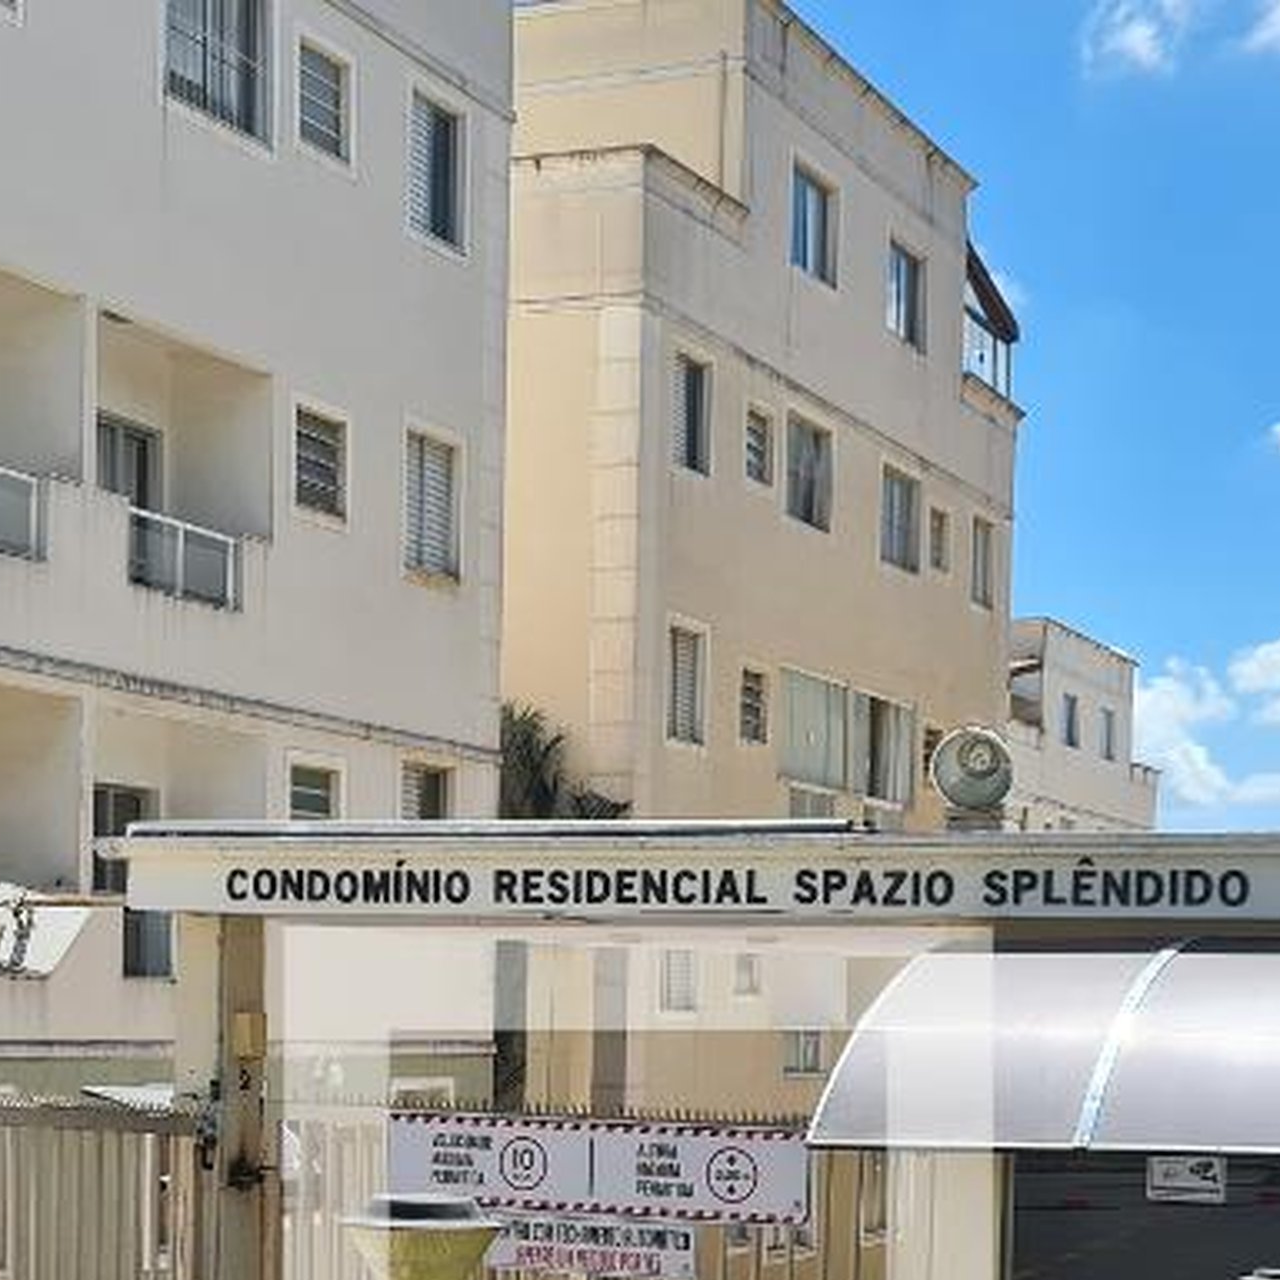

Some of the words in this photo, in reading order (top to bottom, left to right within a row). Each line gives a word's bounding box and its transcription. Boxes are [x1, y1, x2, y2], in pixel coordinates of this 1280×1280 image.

[226, 859, 471, 904] CONDOMÍNIO
[493, 869, 768, 904] RESIDENCIAL
[793, 869, 955, 906] SPAZIO
[983, 855, 1250, 907] SPLÊNDIDO
[512, 1148, 535, 1171] 10
